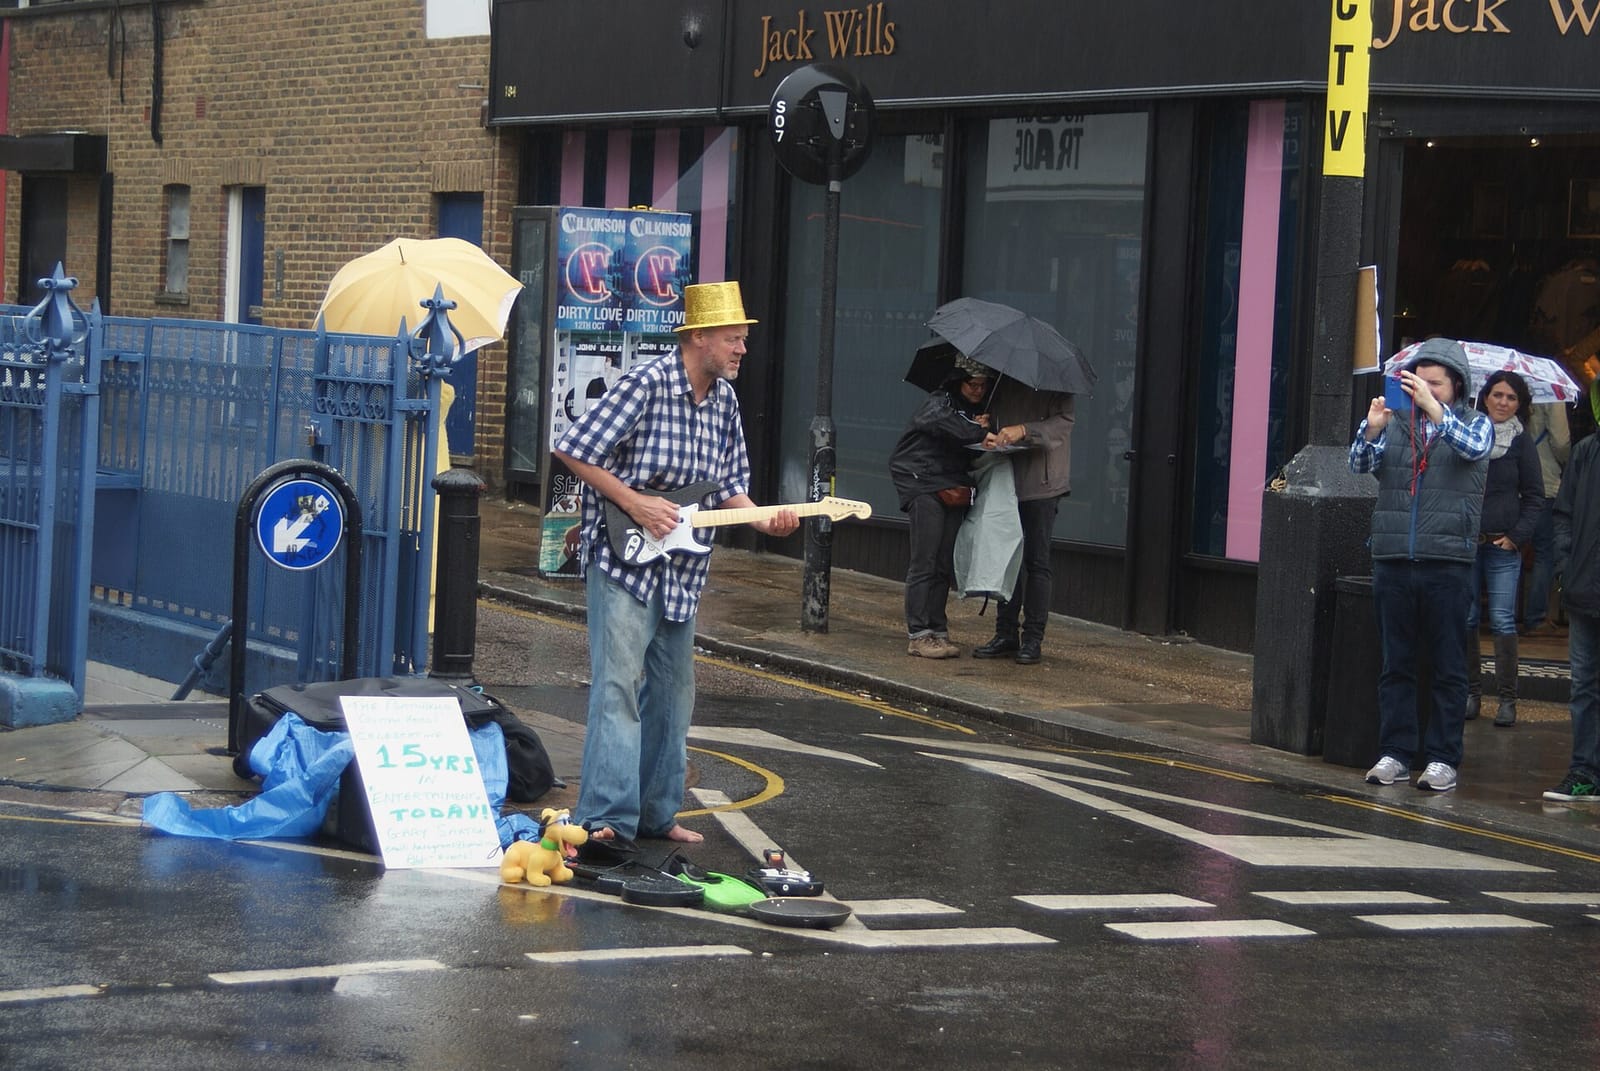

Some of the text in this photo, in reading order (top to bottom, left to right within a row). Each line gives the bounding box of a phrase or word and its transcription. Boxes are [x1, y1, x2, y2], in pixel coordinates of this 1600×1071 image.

[1372, 0, 1511, 49] Jack
[753, 2, 896, 78] Jack Wills
[562, 213, 626, 234] WILKINSON
[629, 217, 692, 237] WILKINSON
[558, 305, 623, 321] DIRTY LOVE
[626, 308, 659, 323] DIRTY
[574, 321, 606, 330] 12TH OCT
[642, 324, 672, 333] 12TH OCT
[576, 343, 597, 352] JOHN
[638, 343, 657, 351] JOHN
[389, 804, 490, 821] TODAY!
